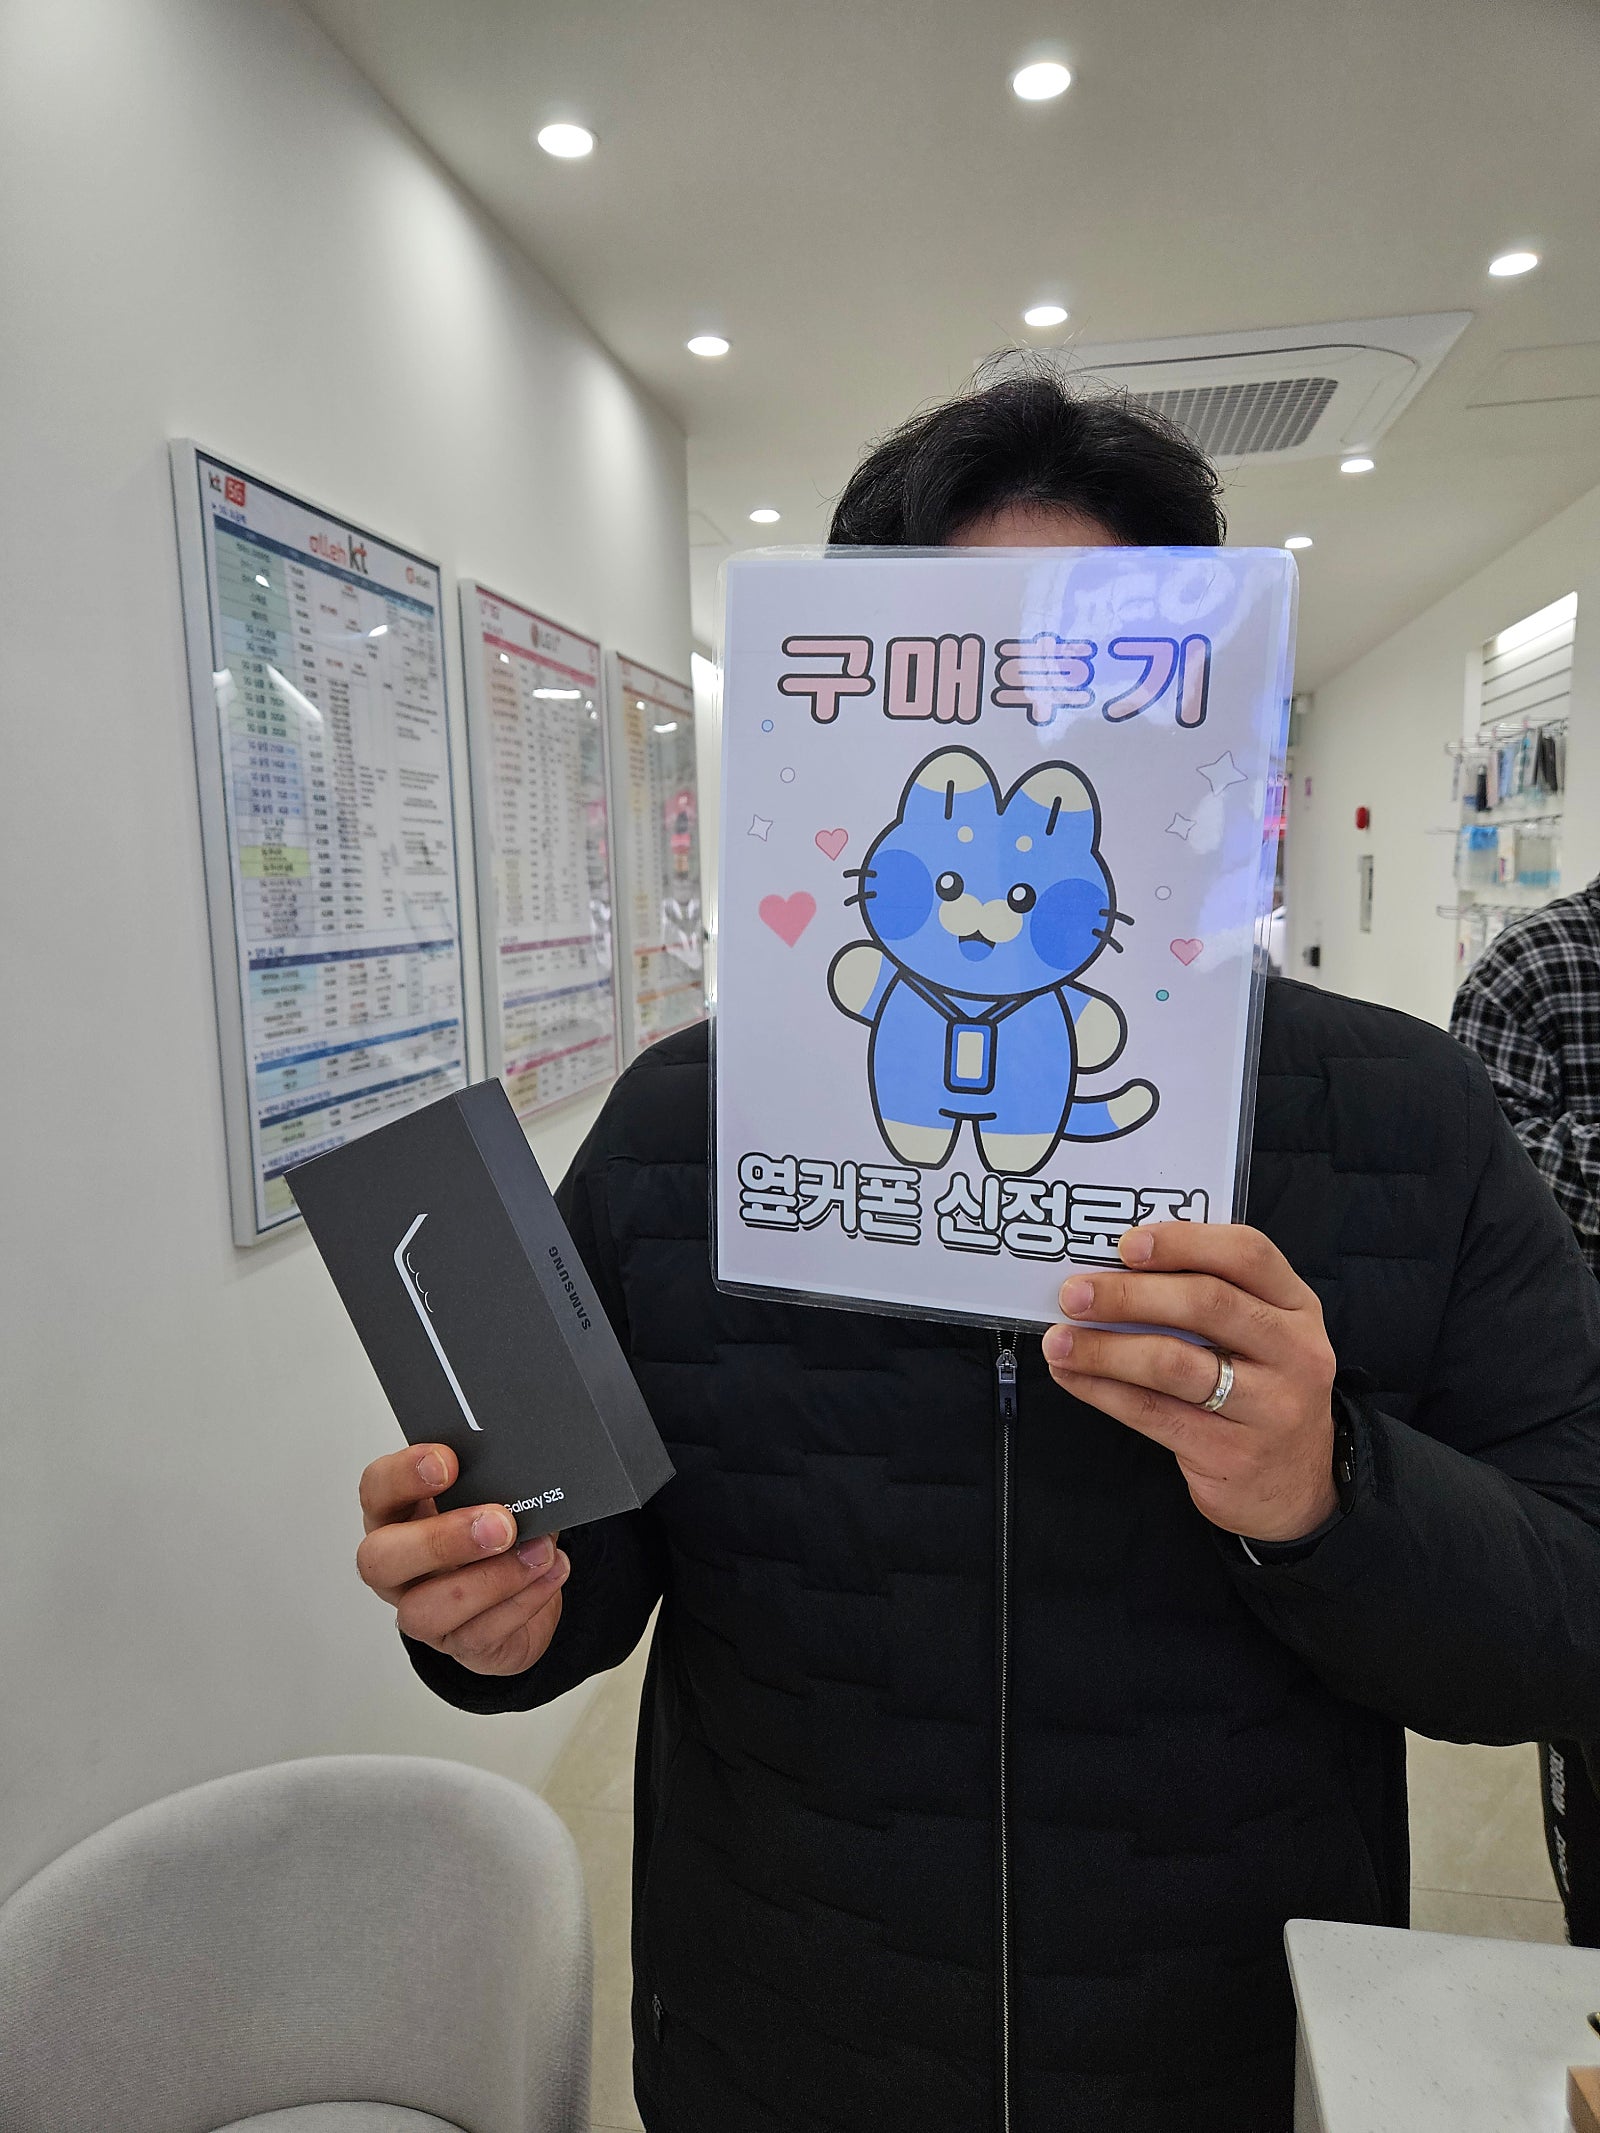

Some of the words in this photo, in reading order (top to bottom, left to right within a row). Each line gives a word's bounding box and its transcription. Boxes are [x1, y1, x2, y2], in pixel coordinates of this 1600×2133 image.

[347, 534, 369, 575] kt
[777, 632, 1212, 729] 구매후기
[737, 1151, 922, 1246] 옆커폰
[548, 1246, 592, 1331] SAMSUNG
[542, 1487, 565, 1504] S25
